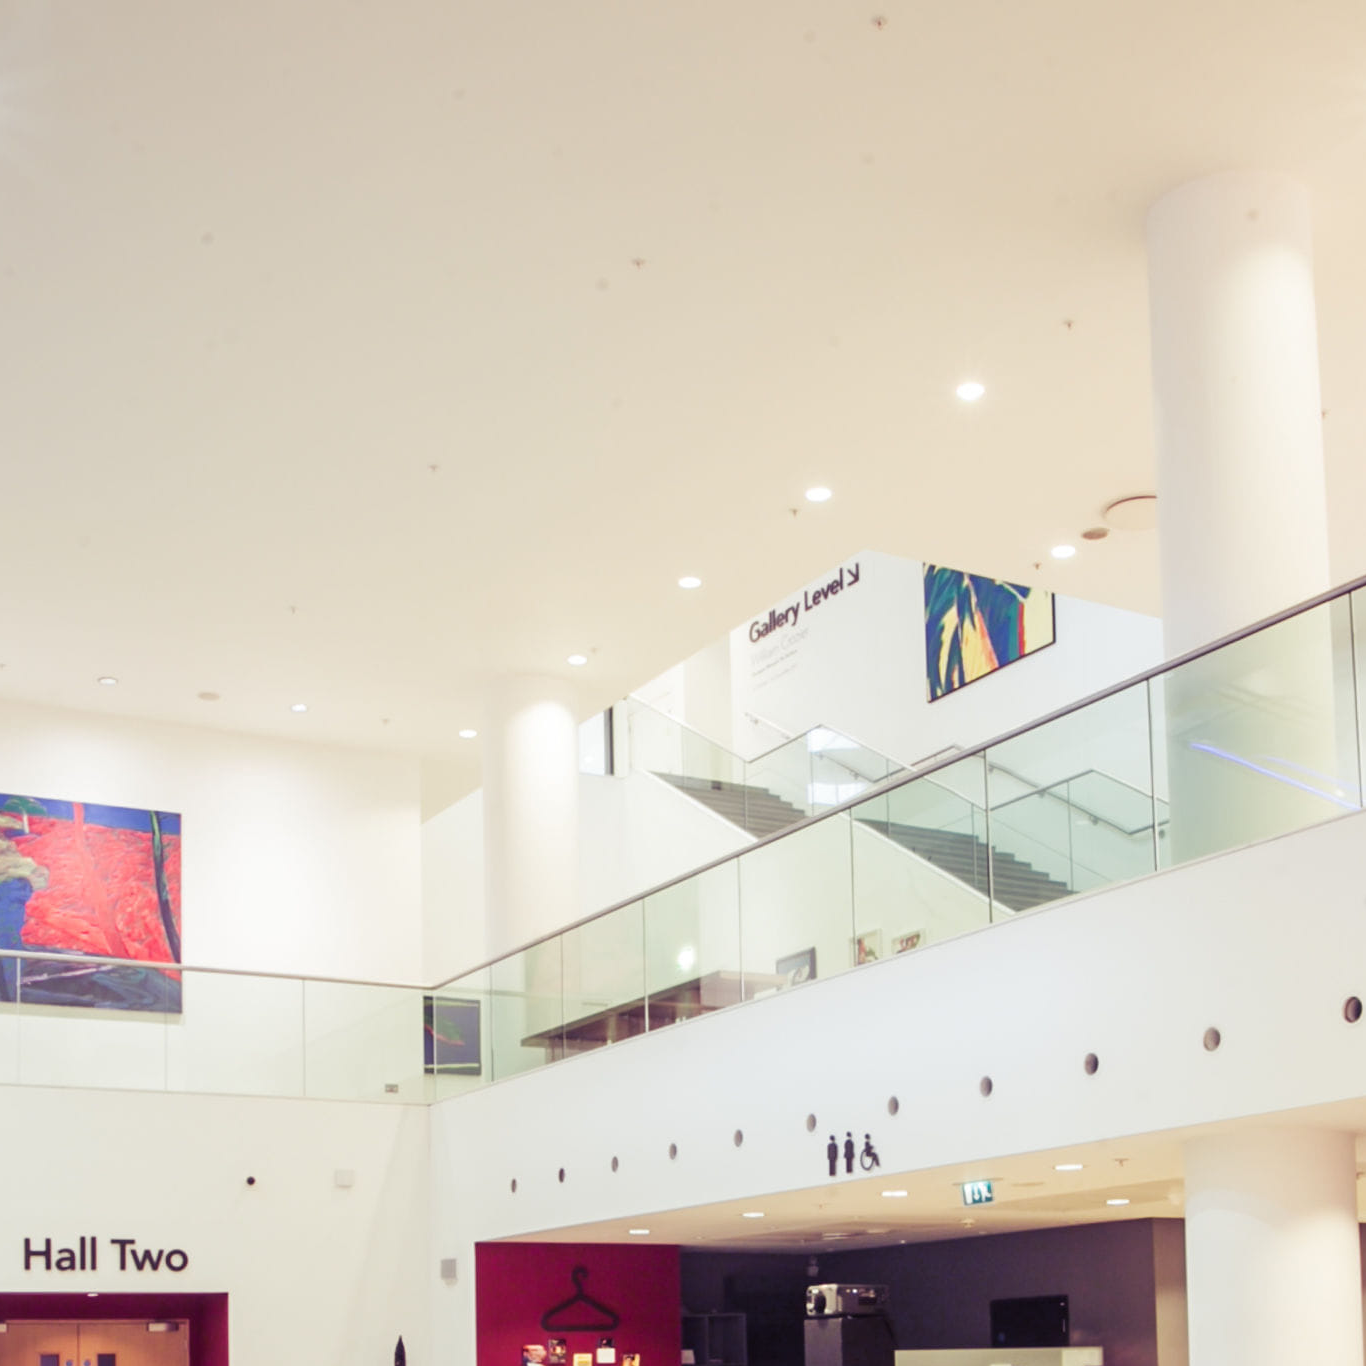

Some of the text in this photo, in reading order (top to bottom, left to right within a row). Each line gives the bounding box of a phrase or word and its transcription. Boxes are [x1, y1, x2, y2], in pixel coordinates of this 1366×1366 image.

[749, 602, 800, 643] Gallery
[804, 567, 843, 612] Level
[23, 1235, 189, 1272] Hall Two
